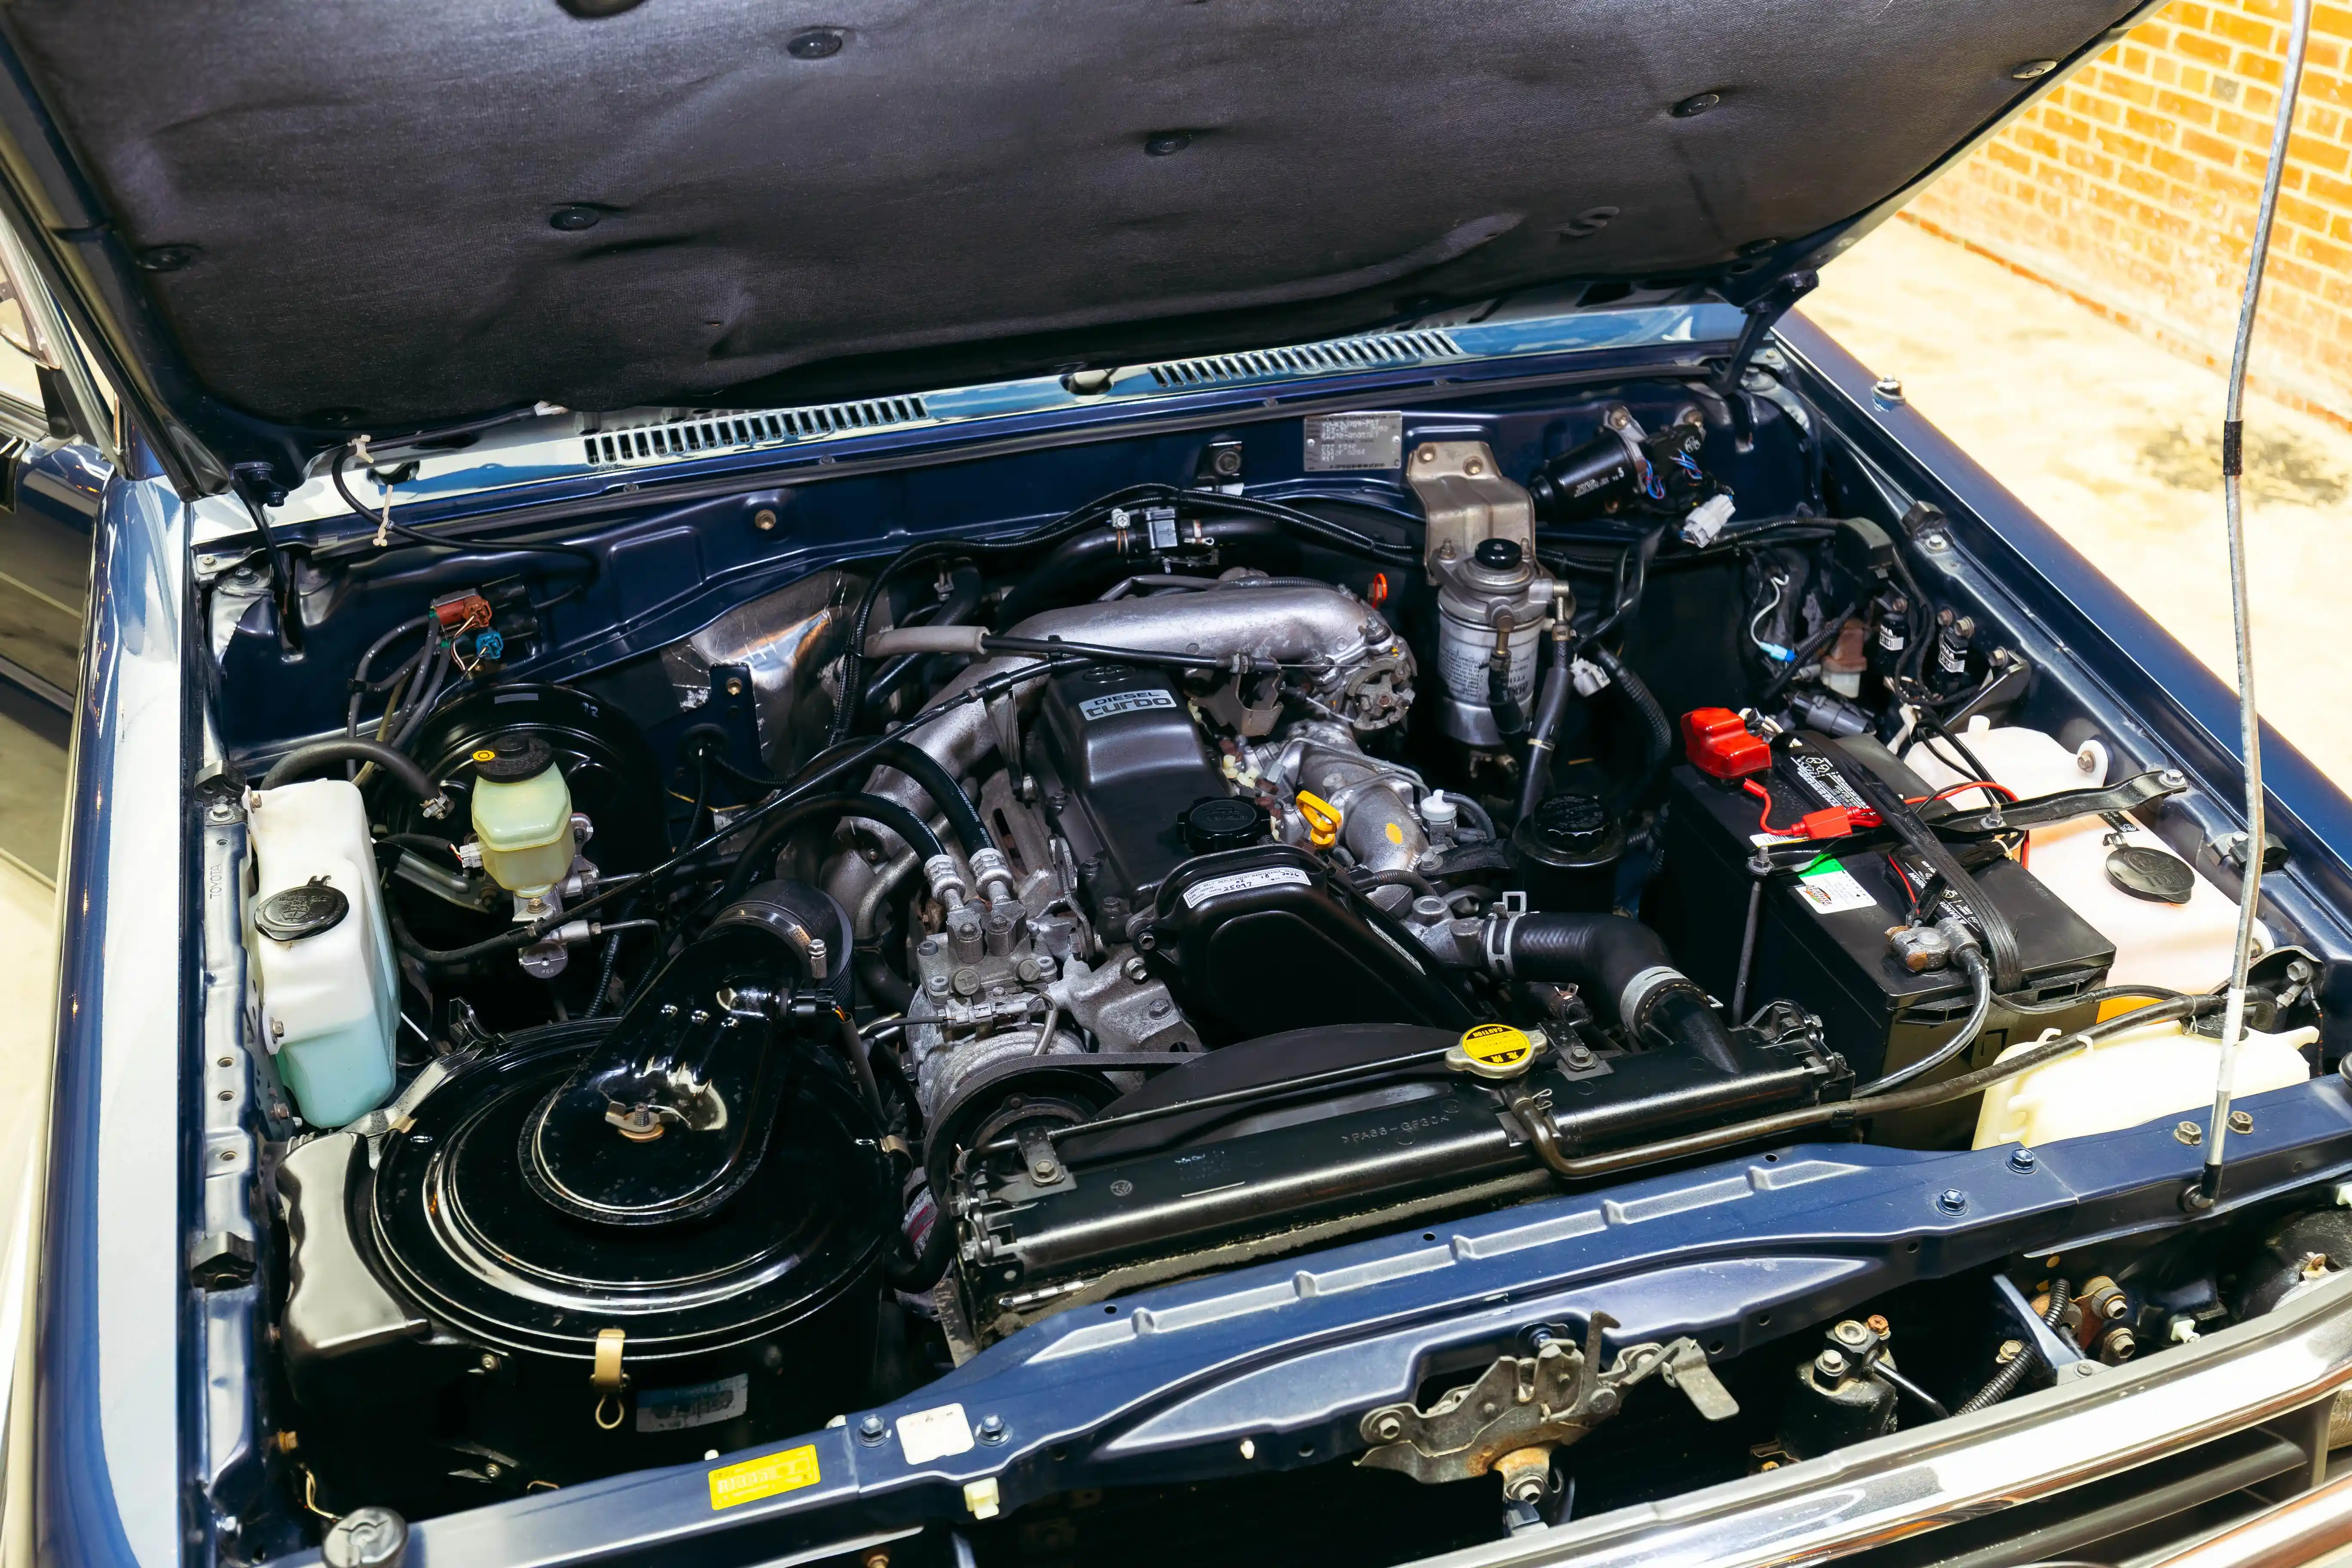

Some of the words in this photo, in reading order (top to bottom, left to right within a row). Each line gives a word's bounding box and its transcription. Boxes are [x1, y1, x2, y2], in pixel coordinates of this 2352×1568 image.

[1095, 692, 1159, 705] DIESEL
[1086, 698, 1172, 717] turbo
[210, 864, 222, 899] TOYOTA
[1188, 887, 1200, 896] TIMING
[1473, 1027, 1503, 1038] CAUTION
